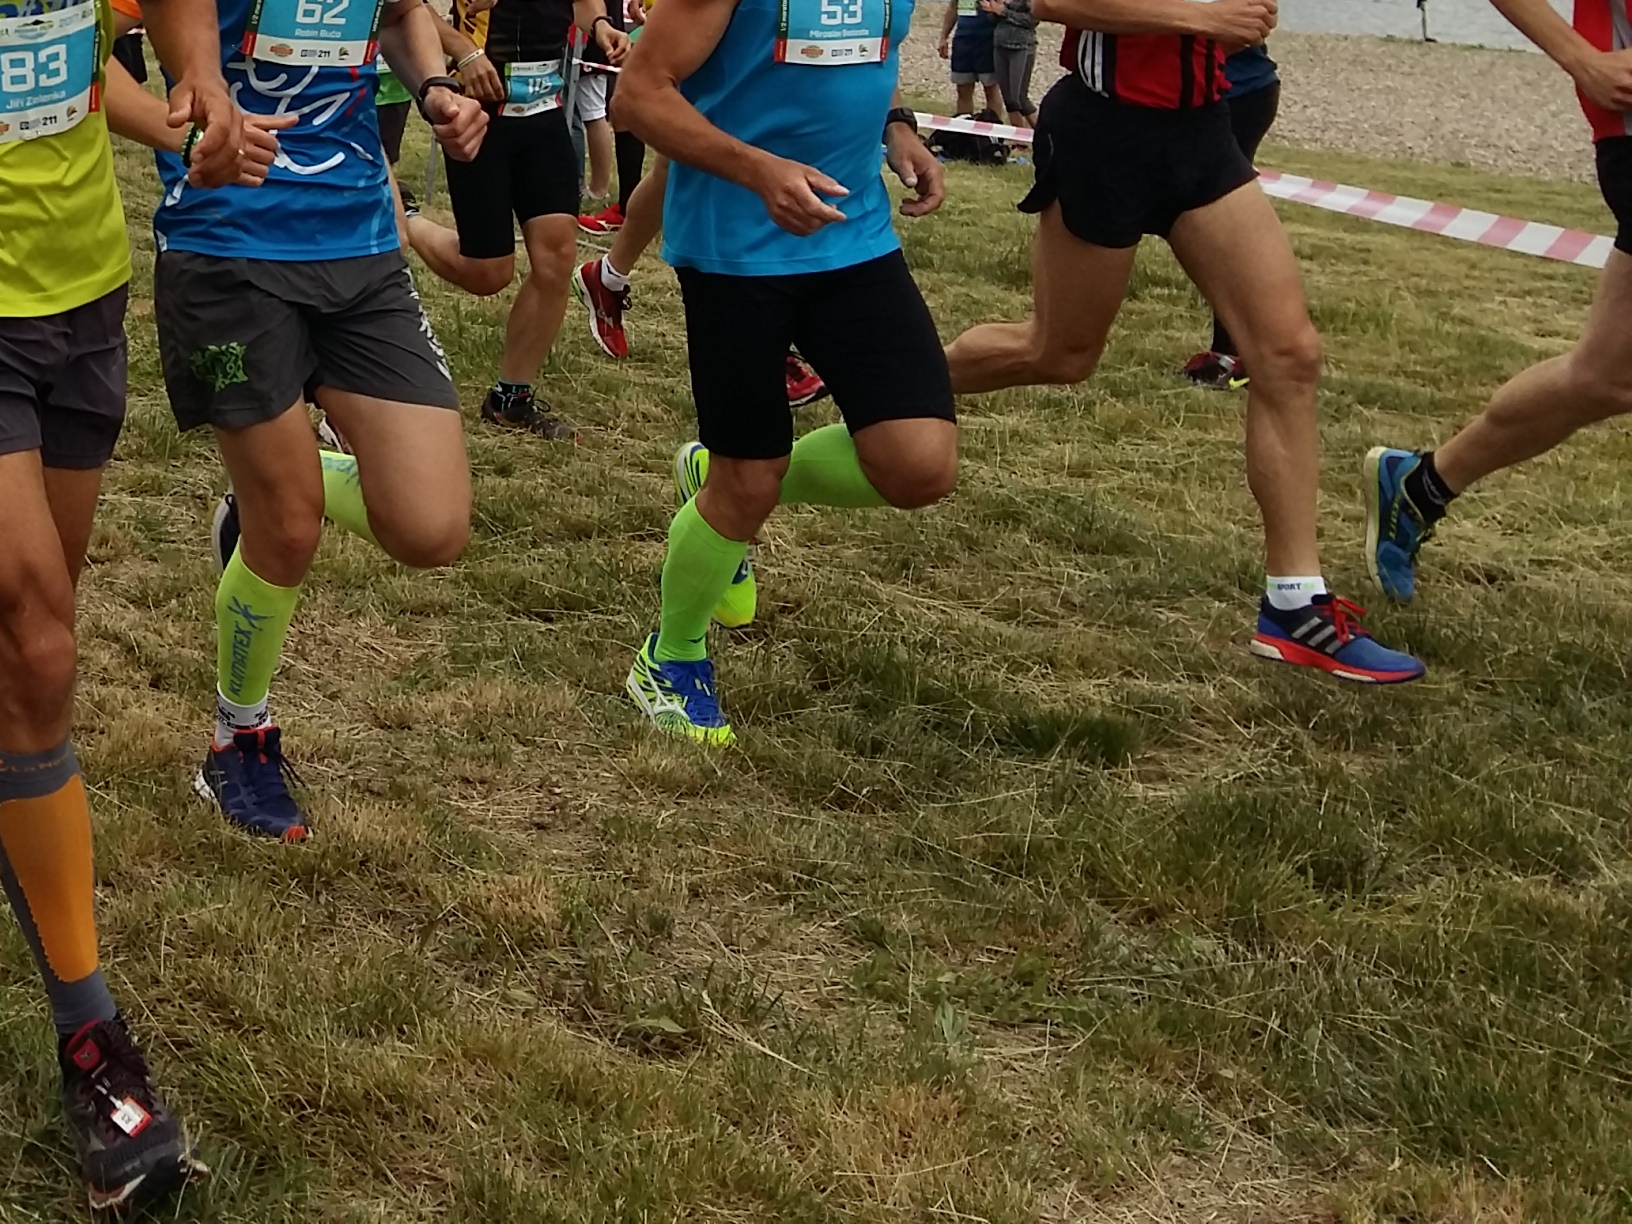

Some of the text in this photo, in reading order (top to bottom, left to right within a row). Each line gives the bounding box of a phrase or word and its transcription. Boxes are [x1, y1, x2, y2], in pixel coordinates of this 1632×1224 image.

[0, 43, 67, 92] 83
[42, 115, 57, 126] 211
[228, 620, 252, 696] KLIMATEX
